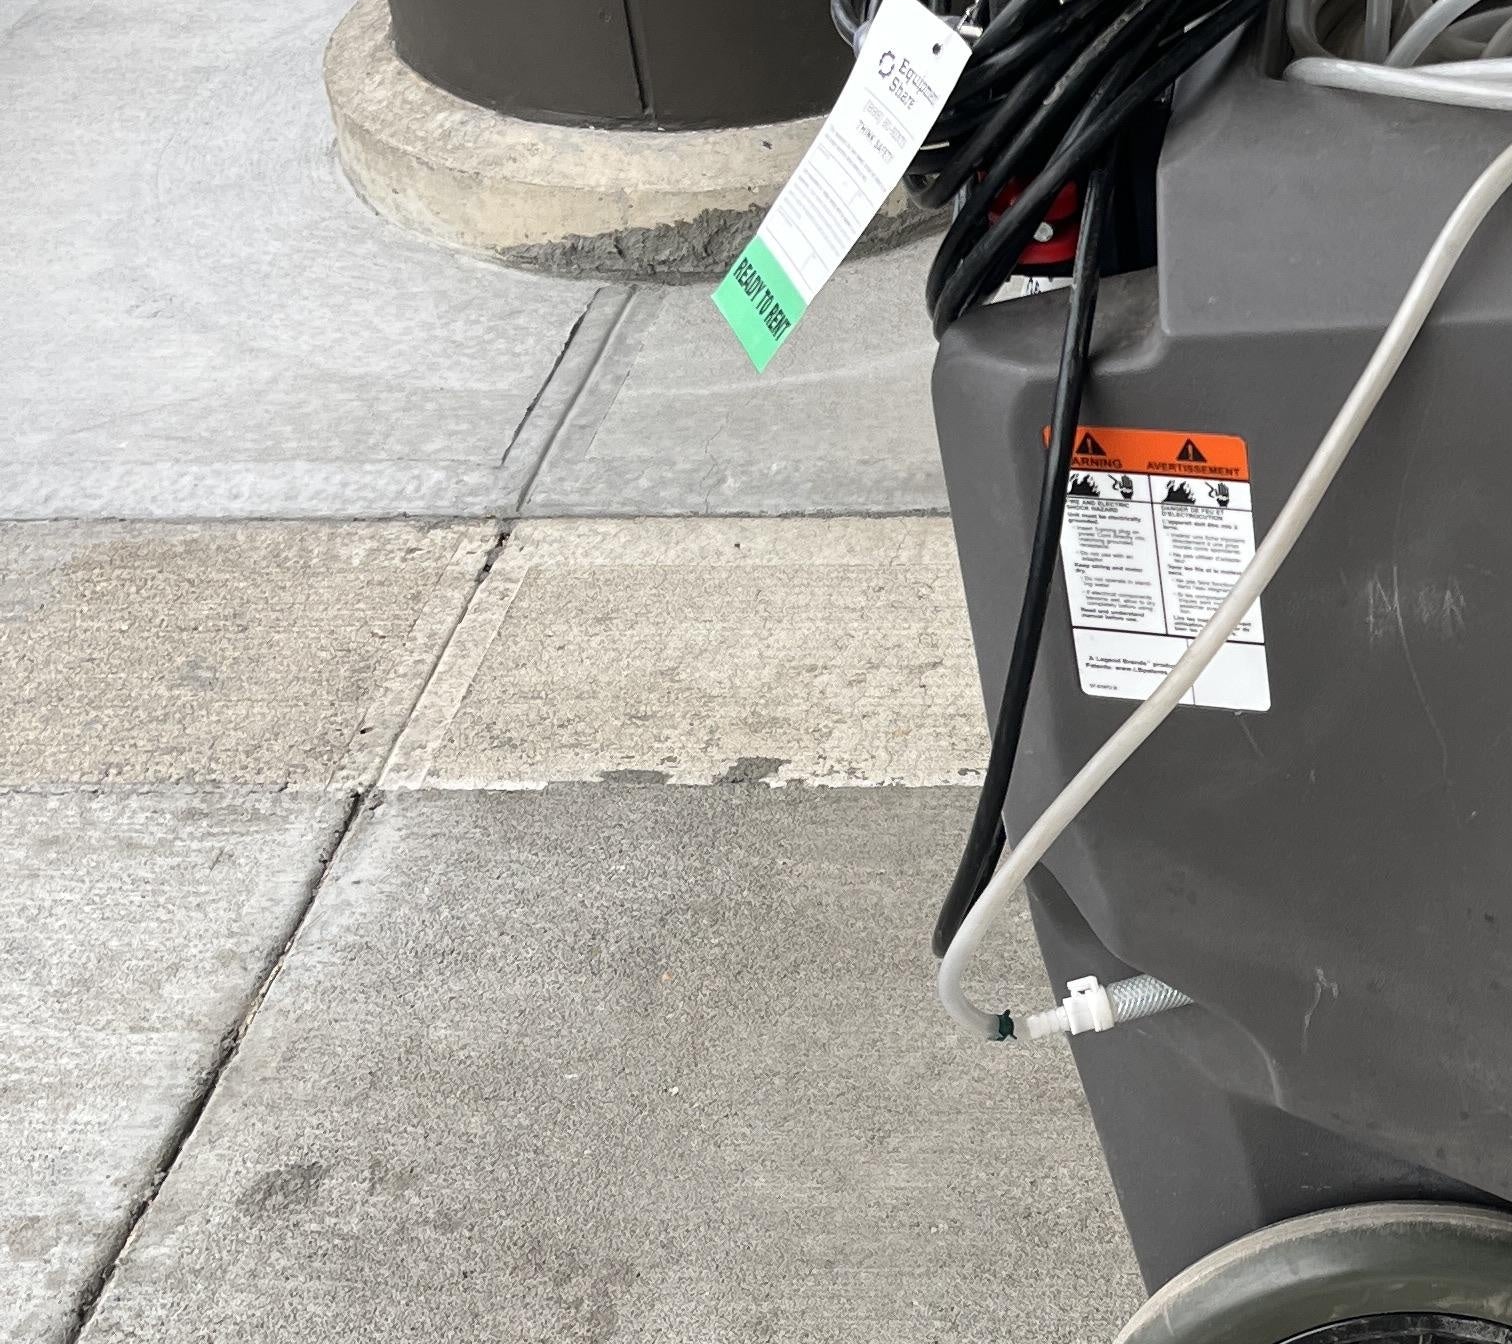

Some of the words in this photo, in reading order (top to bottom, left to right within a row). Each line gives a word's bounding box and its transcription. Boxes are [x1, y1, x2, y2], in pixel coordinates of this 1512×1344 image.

[888, 75, 915, 110] Share
[733, 256, 767, 302] READY
[755, 287, 775, 316] TO
[763, 302, 791, 341] RENT
[1072, 456, 1123, 469] ARNING
[1146, 461, 1240, 476] AVERTISSEMENT
